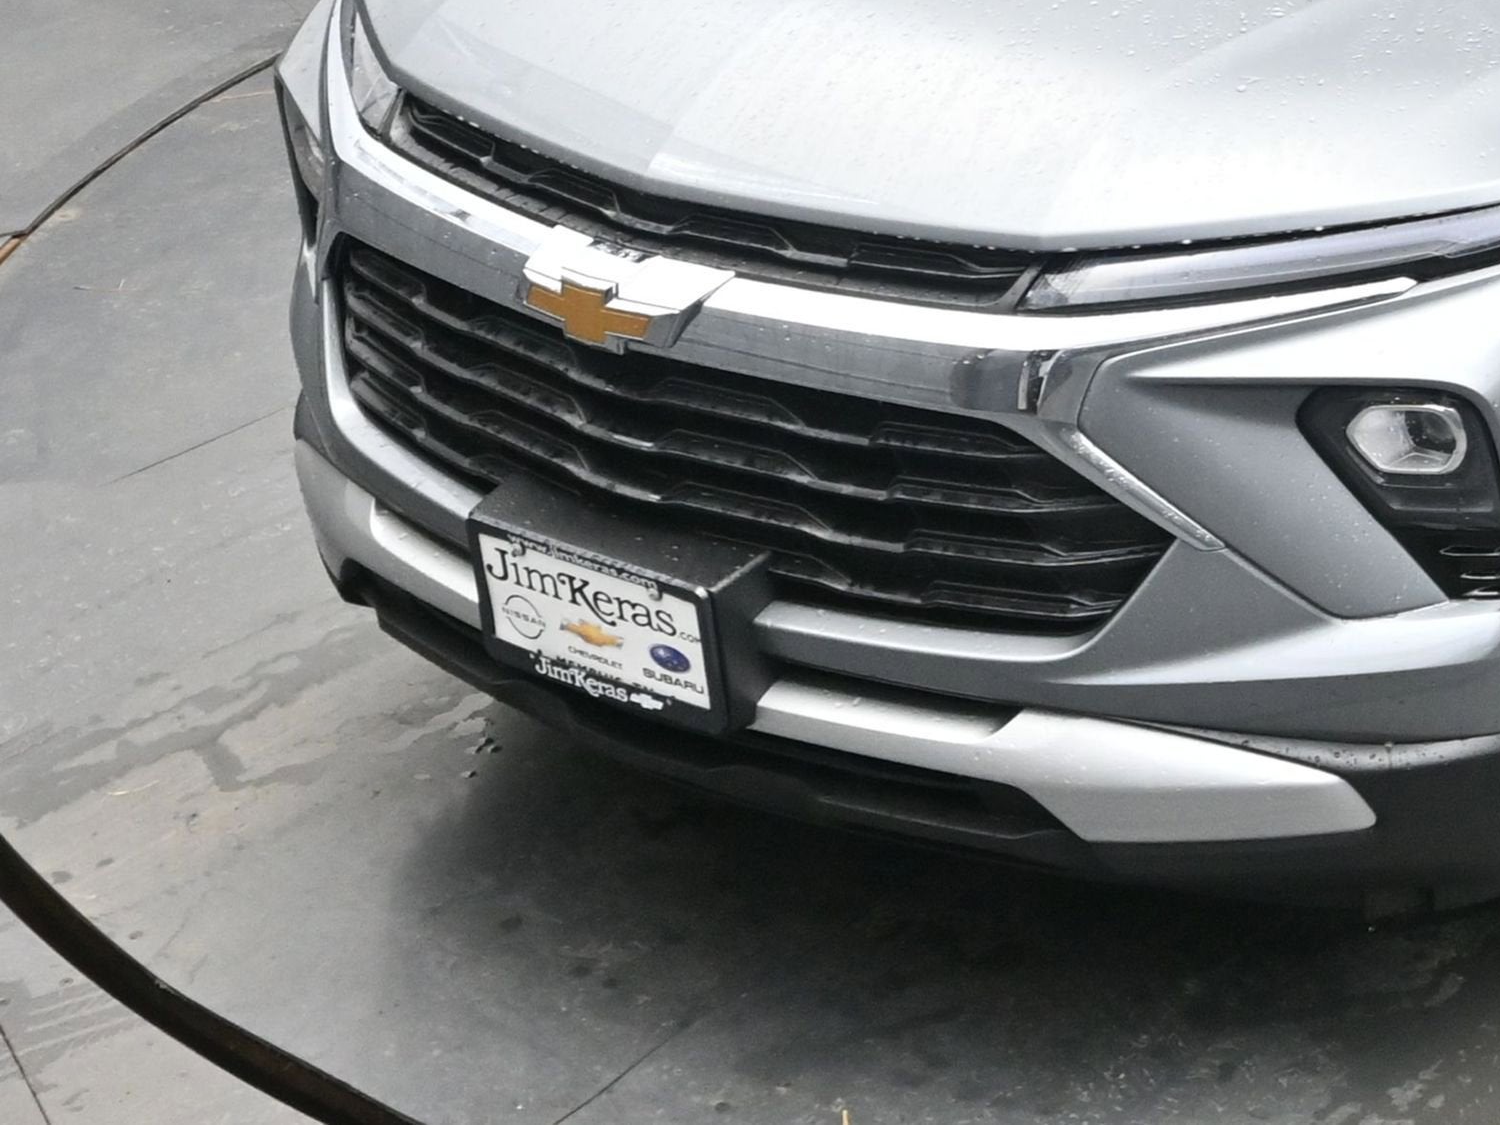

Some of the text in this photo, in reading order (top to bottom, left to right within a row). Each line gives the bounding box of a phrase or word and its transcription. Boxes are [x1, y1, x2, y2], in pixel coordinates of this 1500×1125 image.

[501, 606, 546, 628] NISSAN
[567, 645, 623, 669] CHEVROLET
[642, 667, 705, 695] SUBARU
